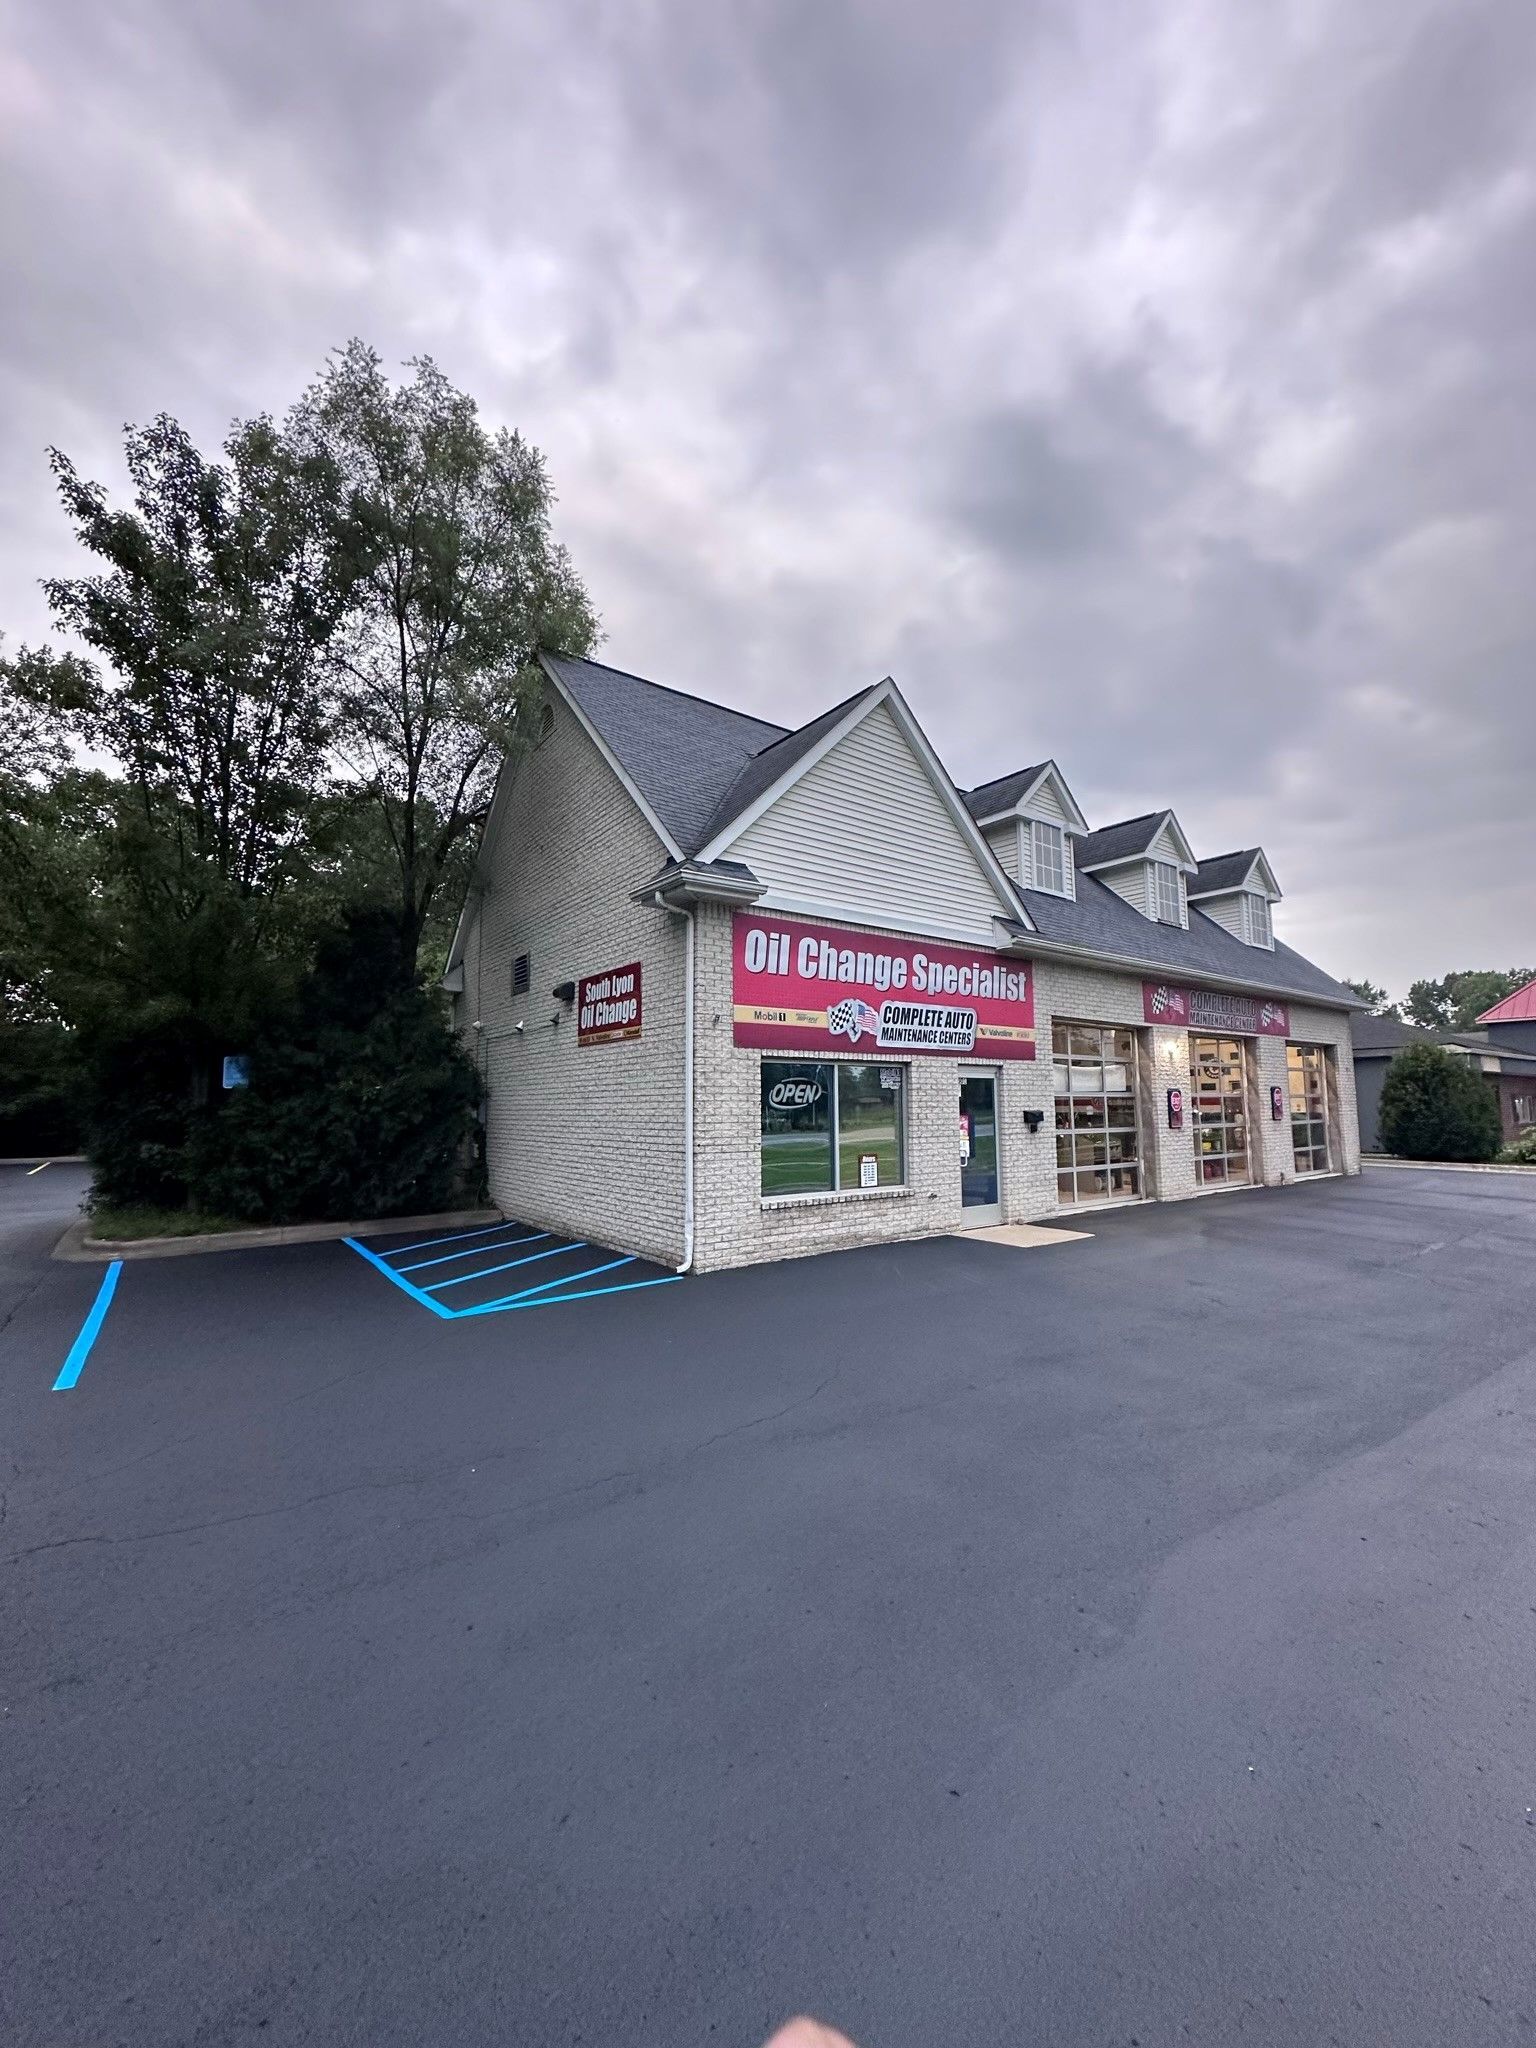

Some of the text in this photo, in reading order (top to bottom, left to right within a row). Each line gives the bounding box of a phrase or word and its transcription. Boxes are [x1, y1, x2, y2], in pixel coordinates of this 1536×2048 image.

[744, 929, 1027, 1002] Oil Change Specialist
[585, 973, 635, 1003] South Lyon
[580, 998, 637, 1029] Oil Change
[754, 1011, 778, 1021] Mobil
[778, 1012, 786, 1021] 1
[883, 1005, 974, 1030] COMPLETE AUTO
[1189, 1010, 1234, 1028] MAINTENANCE
[881, 1026, 972, 1046] MAINTENANCE CENTERS
[772, 1083, 817, 1104] OPEN
